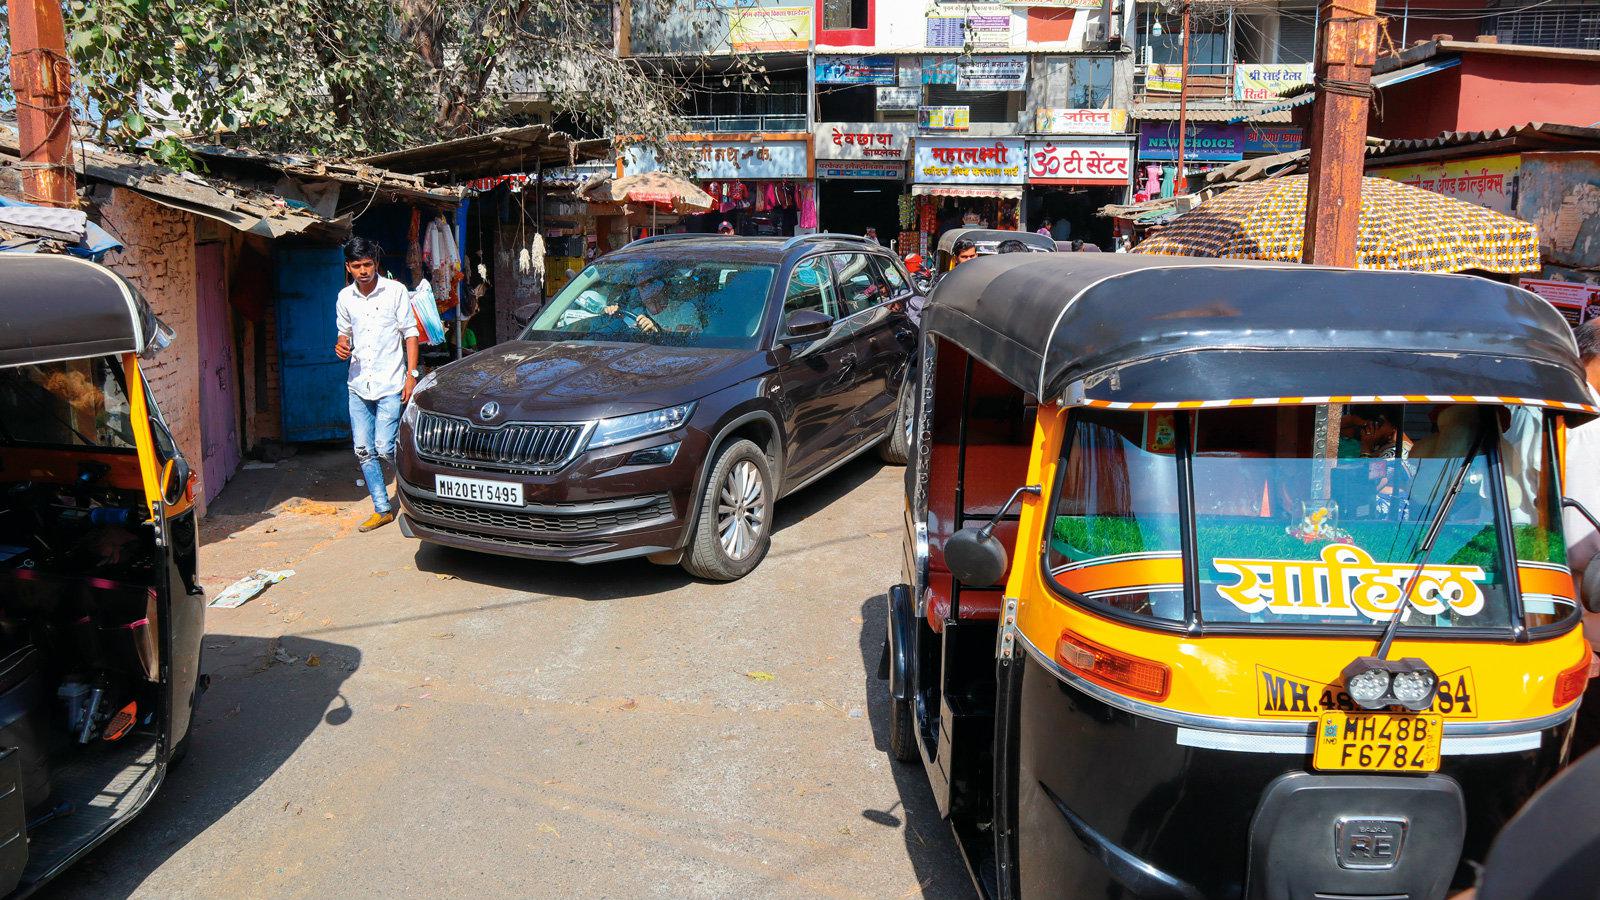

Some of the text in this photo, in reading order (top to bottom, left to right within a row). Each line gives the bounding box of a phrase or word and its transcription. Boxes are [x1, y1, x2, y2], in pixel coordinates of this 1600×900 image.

[1248, 69, 1302, 81] श्री साई टेलर
[1062, 110, 1110, 123] जतिन
[931, 142, 1008, 163] महालक्ष्मी
[1148, 138, 1234, 148] NEW CHOICE
[1063, 150, 1083, 173] टी
[1086, 151, 1128, 175] सेंटर
[1211, 543, 1486, 621] साहिल
[1344, 717, 1428, 741] MH48B
[1341, 744, 1425, 768] F6784
[1349, 834, 1393, 859] RE
